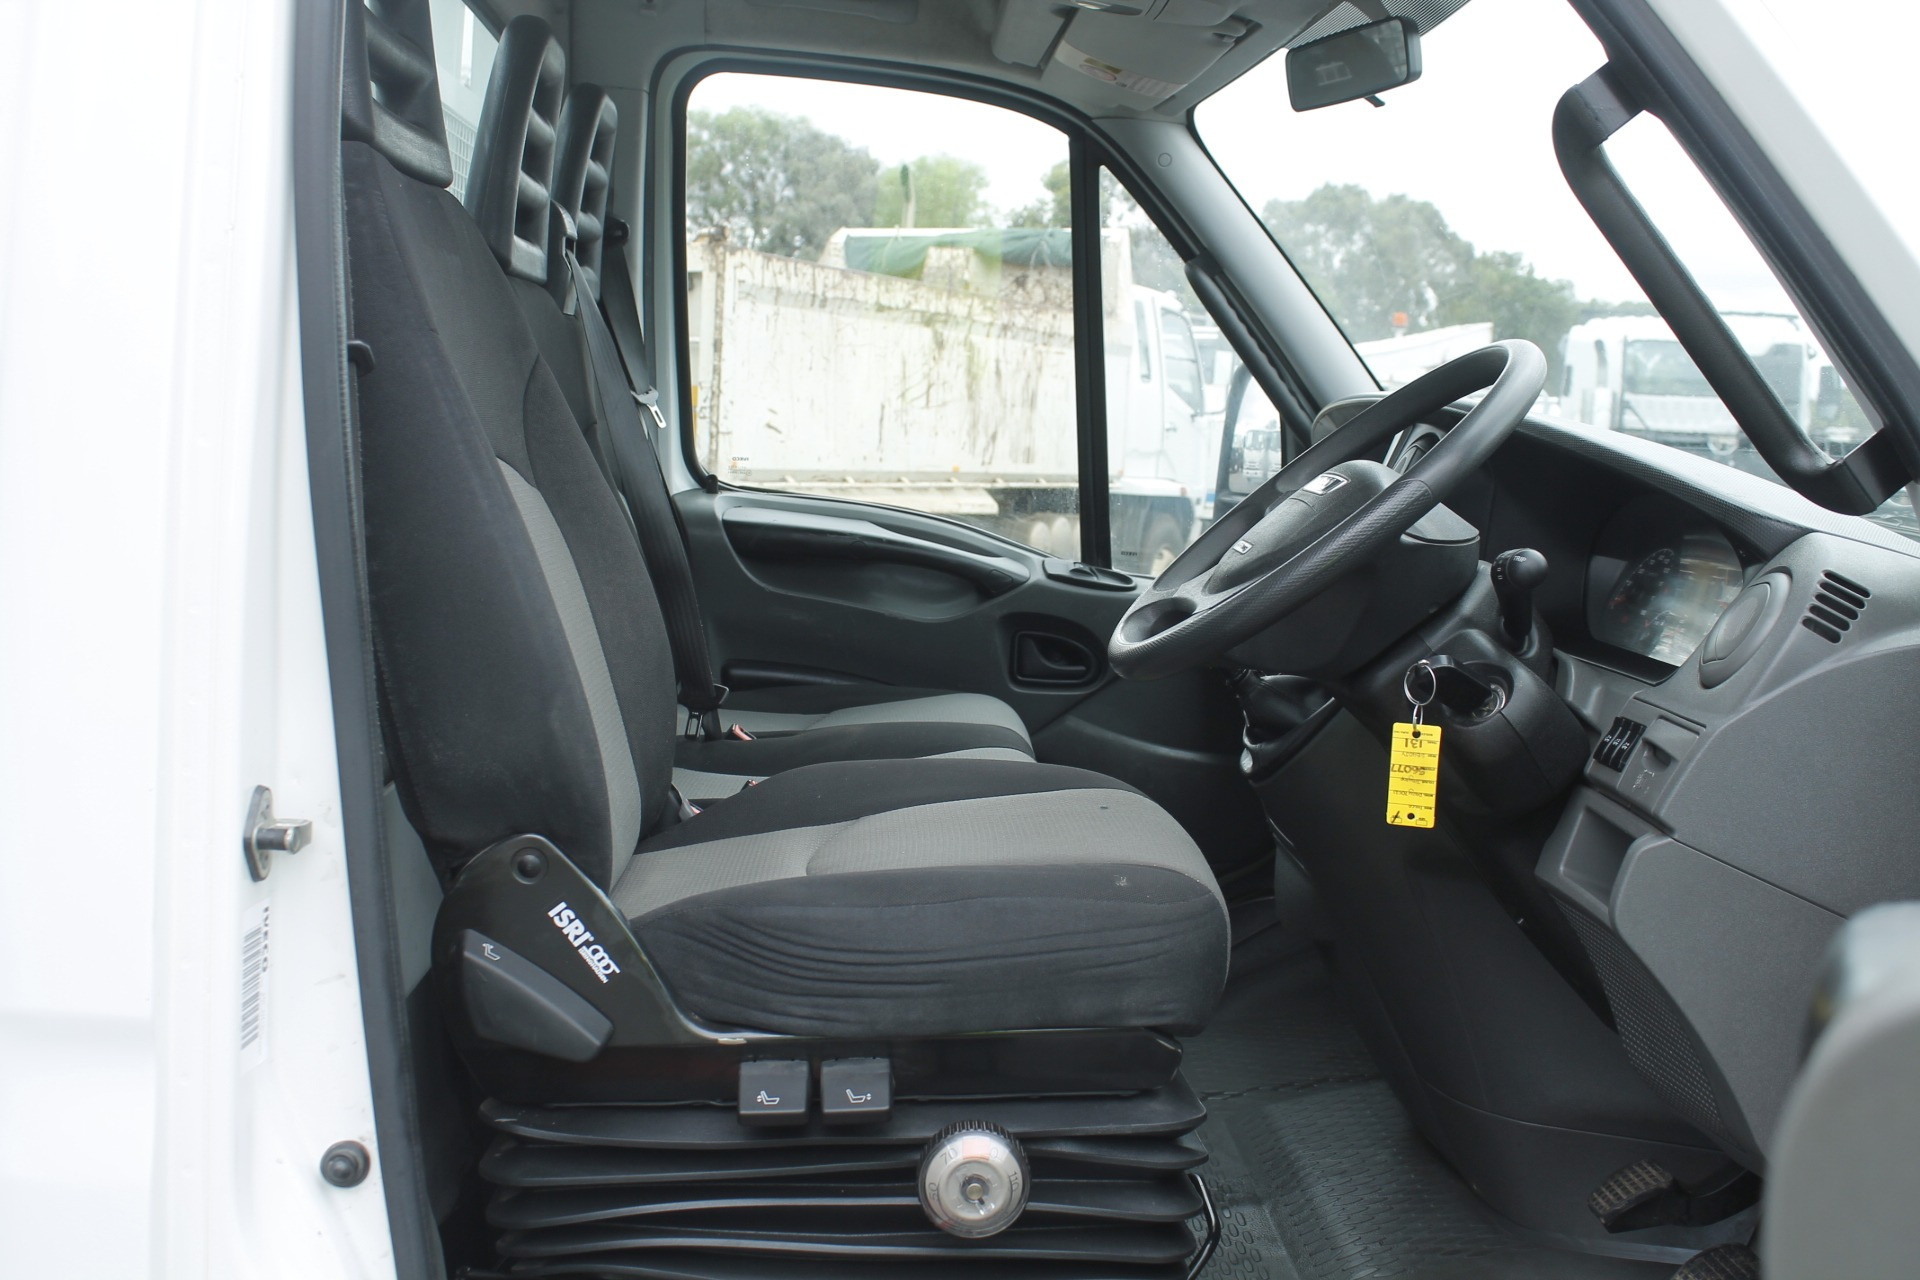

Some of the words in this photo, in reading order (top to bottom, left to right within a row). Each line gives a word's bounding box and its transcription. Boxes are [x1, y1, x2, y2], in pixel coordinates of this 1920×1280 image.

[1404, 738, 1422, 748] 131
[262, 906, 270, 973] IVECO
[939, 1147, 958, 1165] 70
